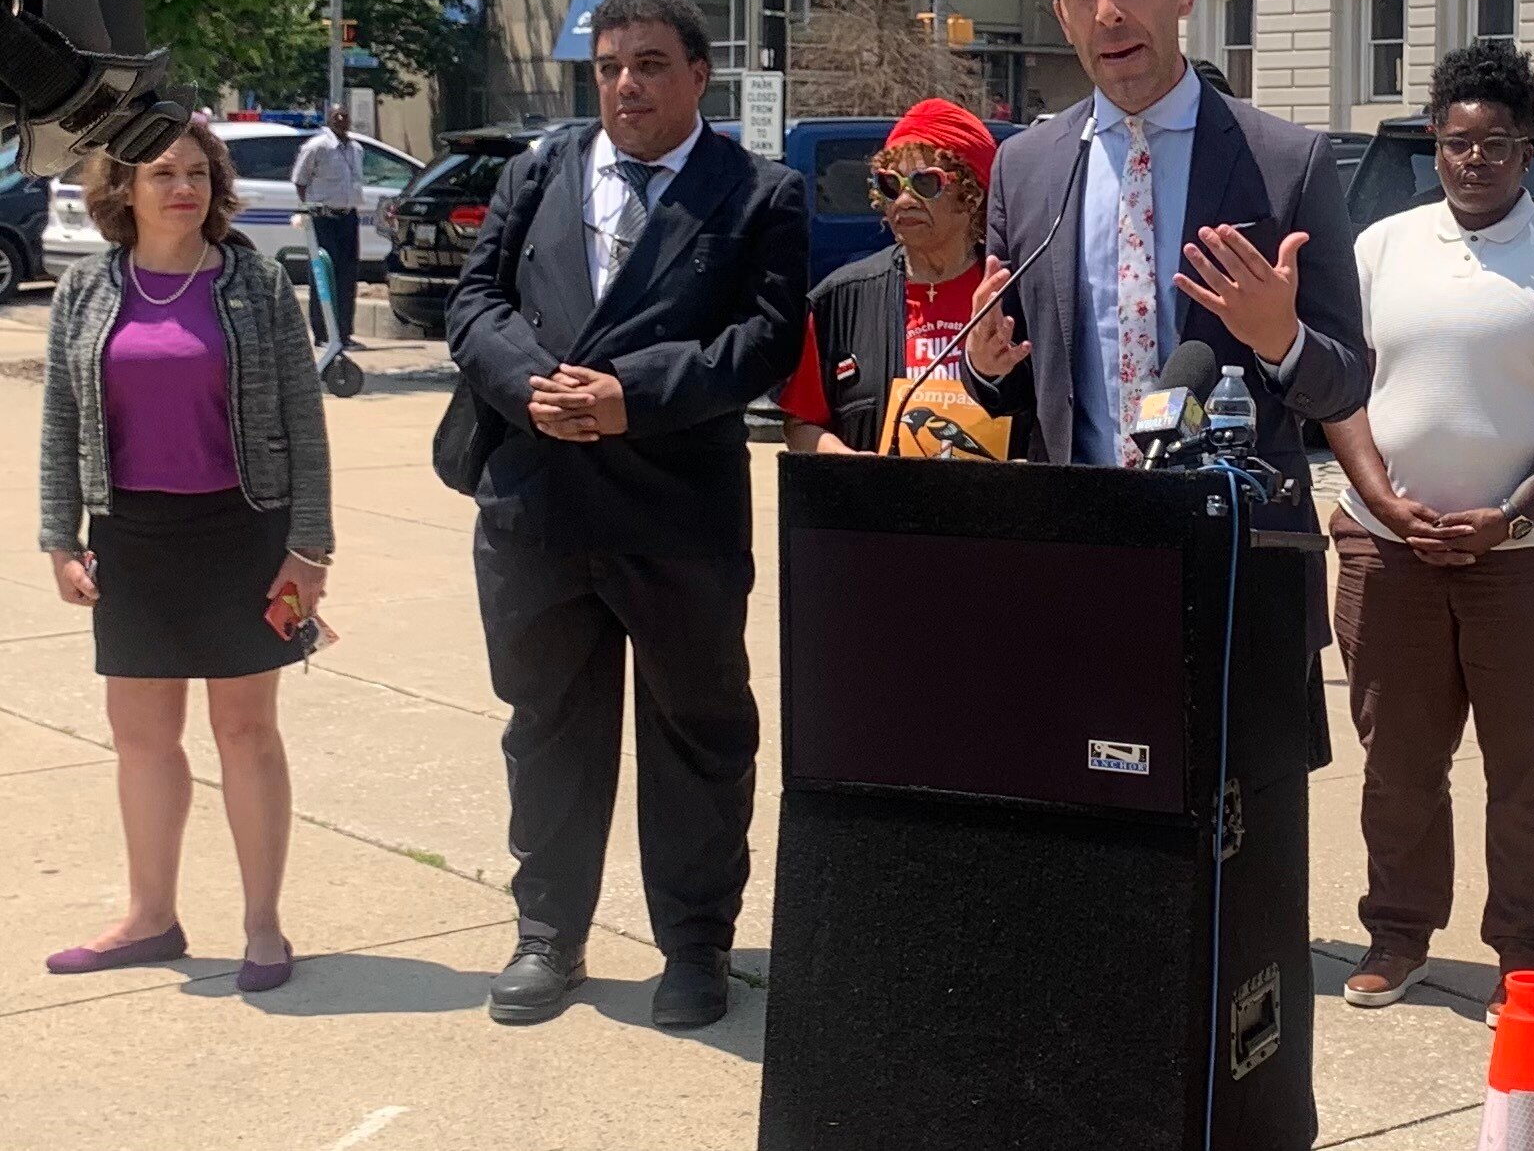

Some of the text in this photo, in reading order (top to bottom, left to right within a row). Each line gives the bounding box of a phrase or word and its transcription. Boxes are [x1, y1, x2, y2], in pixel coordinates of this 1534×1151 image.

[752, 80, 772, 88] PARK
[747, 92, 777, 102] CLOSED
[751, 105, 773, 114] FROM
[751, 116, 772, 126] DUSK
[756, 128, 768, 138] TO
[750, 140, 773, 150] DAWN
[936, 319, 965, 331] Pratt
[915, 334, 962, 360] FULL
[1090, 758, 1148, 773] ANCHOR
